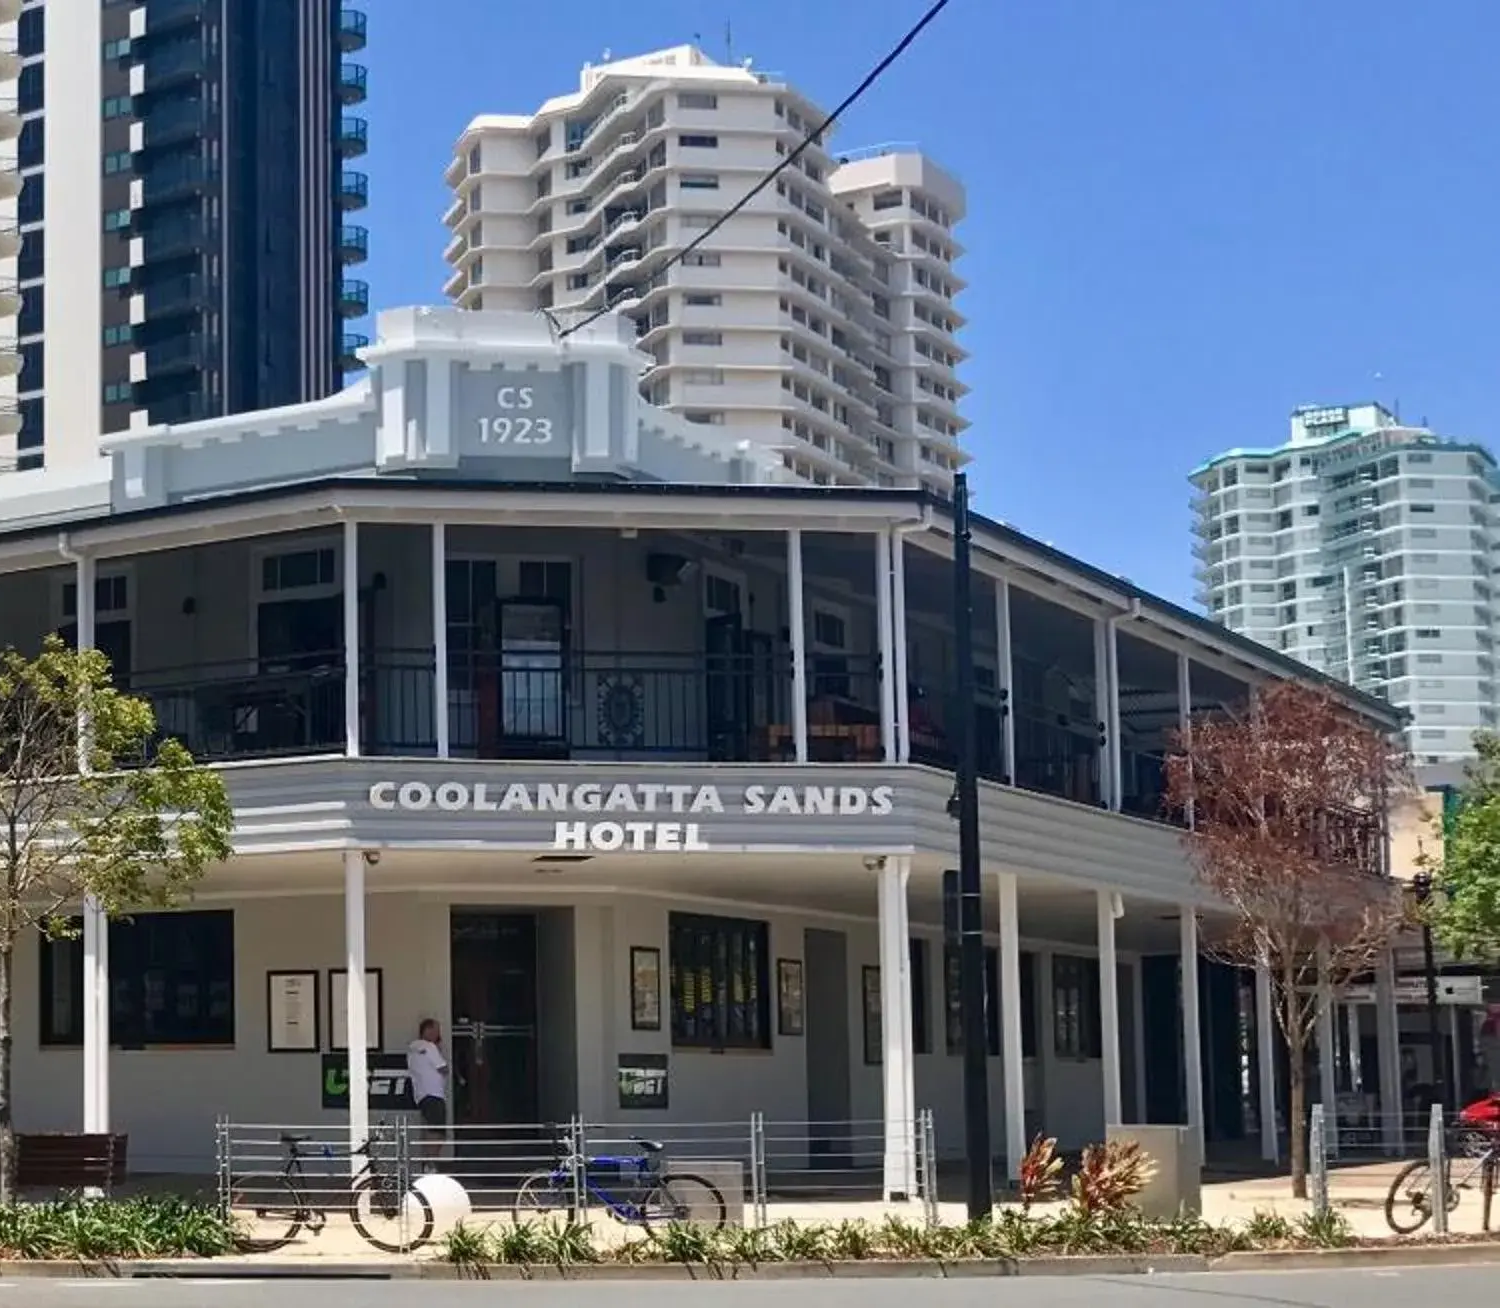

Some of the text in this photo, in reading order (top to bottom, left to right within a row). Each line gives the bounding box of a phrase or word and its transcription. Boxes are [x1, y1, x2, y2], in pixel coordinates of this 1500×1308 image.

[498, 387, 533, 408] CS
[479, 418, 552, 443] 1923
[369, 781, 894, 816] COOLANGATTA SANDS
[552, 820, 709, 851] HOTEL
